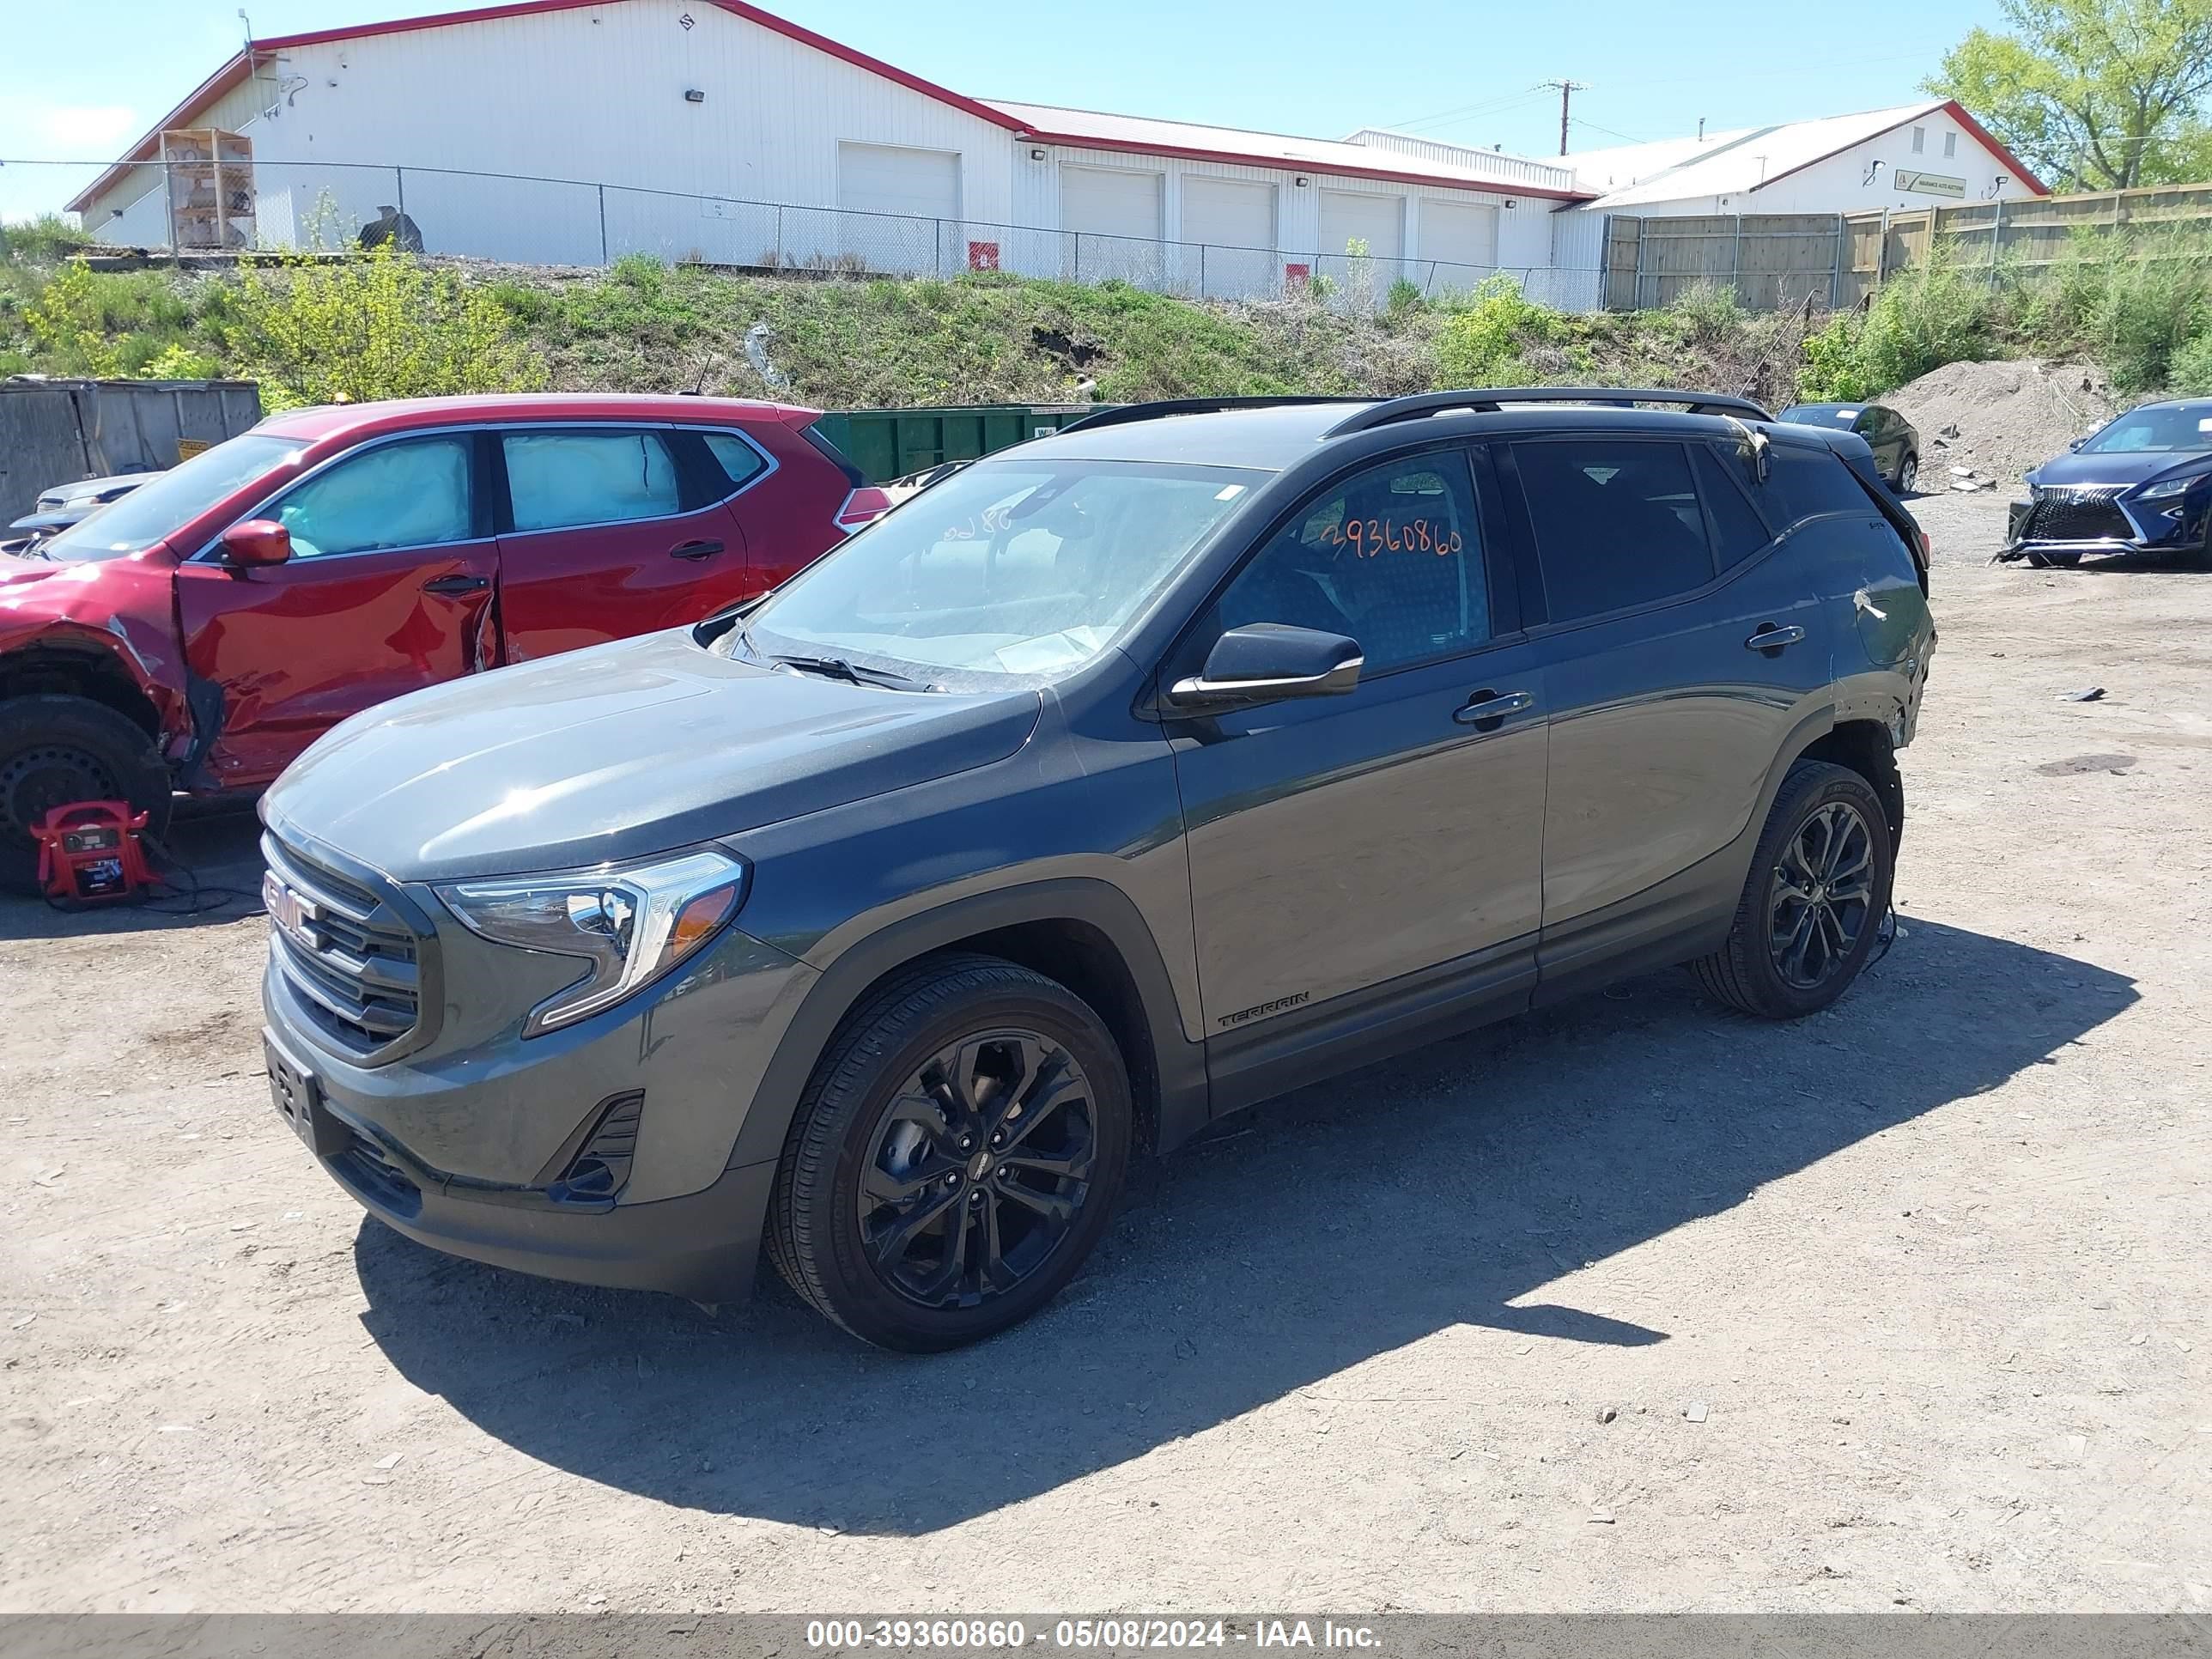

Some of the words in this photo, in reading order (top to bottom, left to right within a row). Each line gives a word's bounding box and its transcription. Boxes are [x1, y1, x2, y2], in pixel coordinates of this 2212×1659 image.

[1319, 518, 1462, 561] 39360860
[262, 869, 325, 949] GMC
[1217, 991, 1310, 1027] TERRAIN
